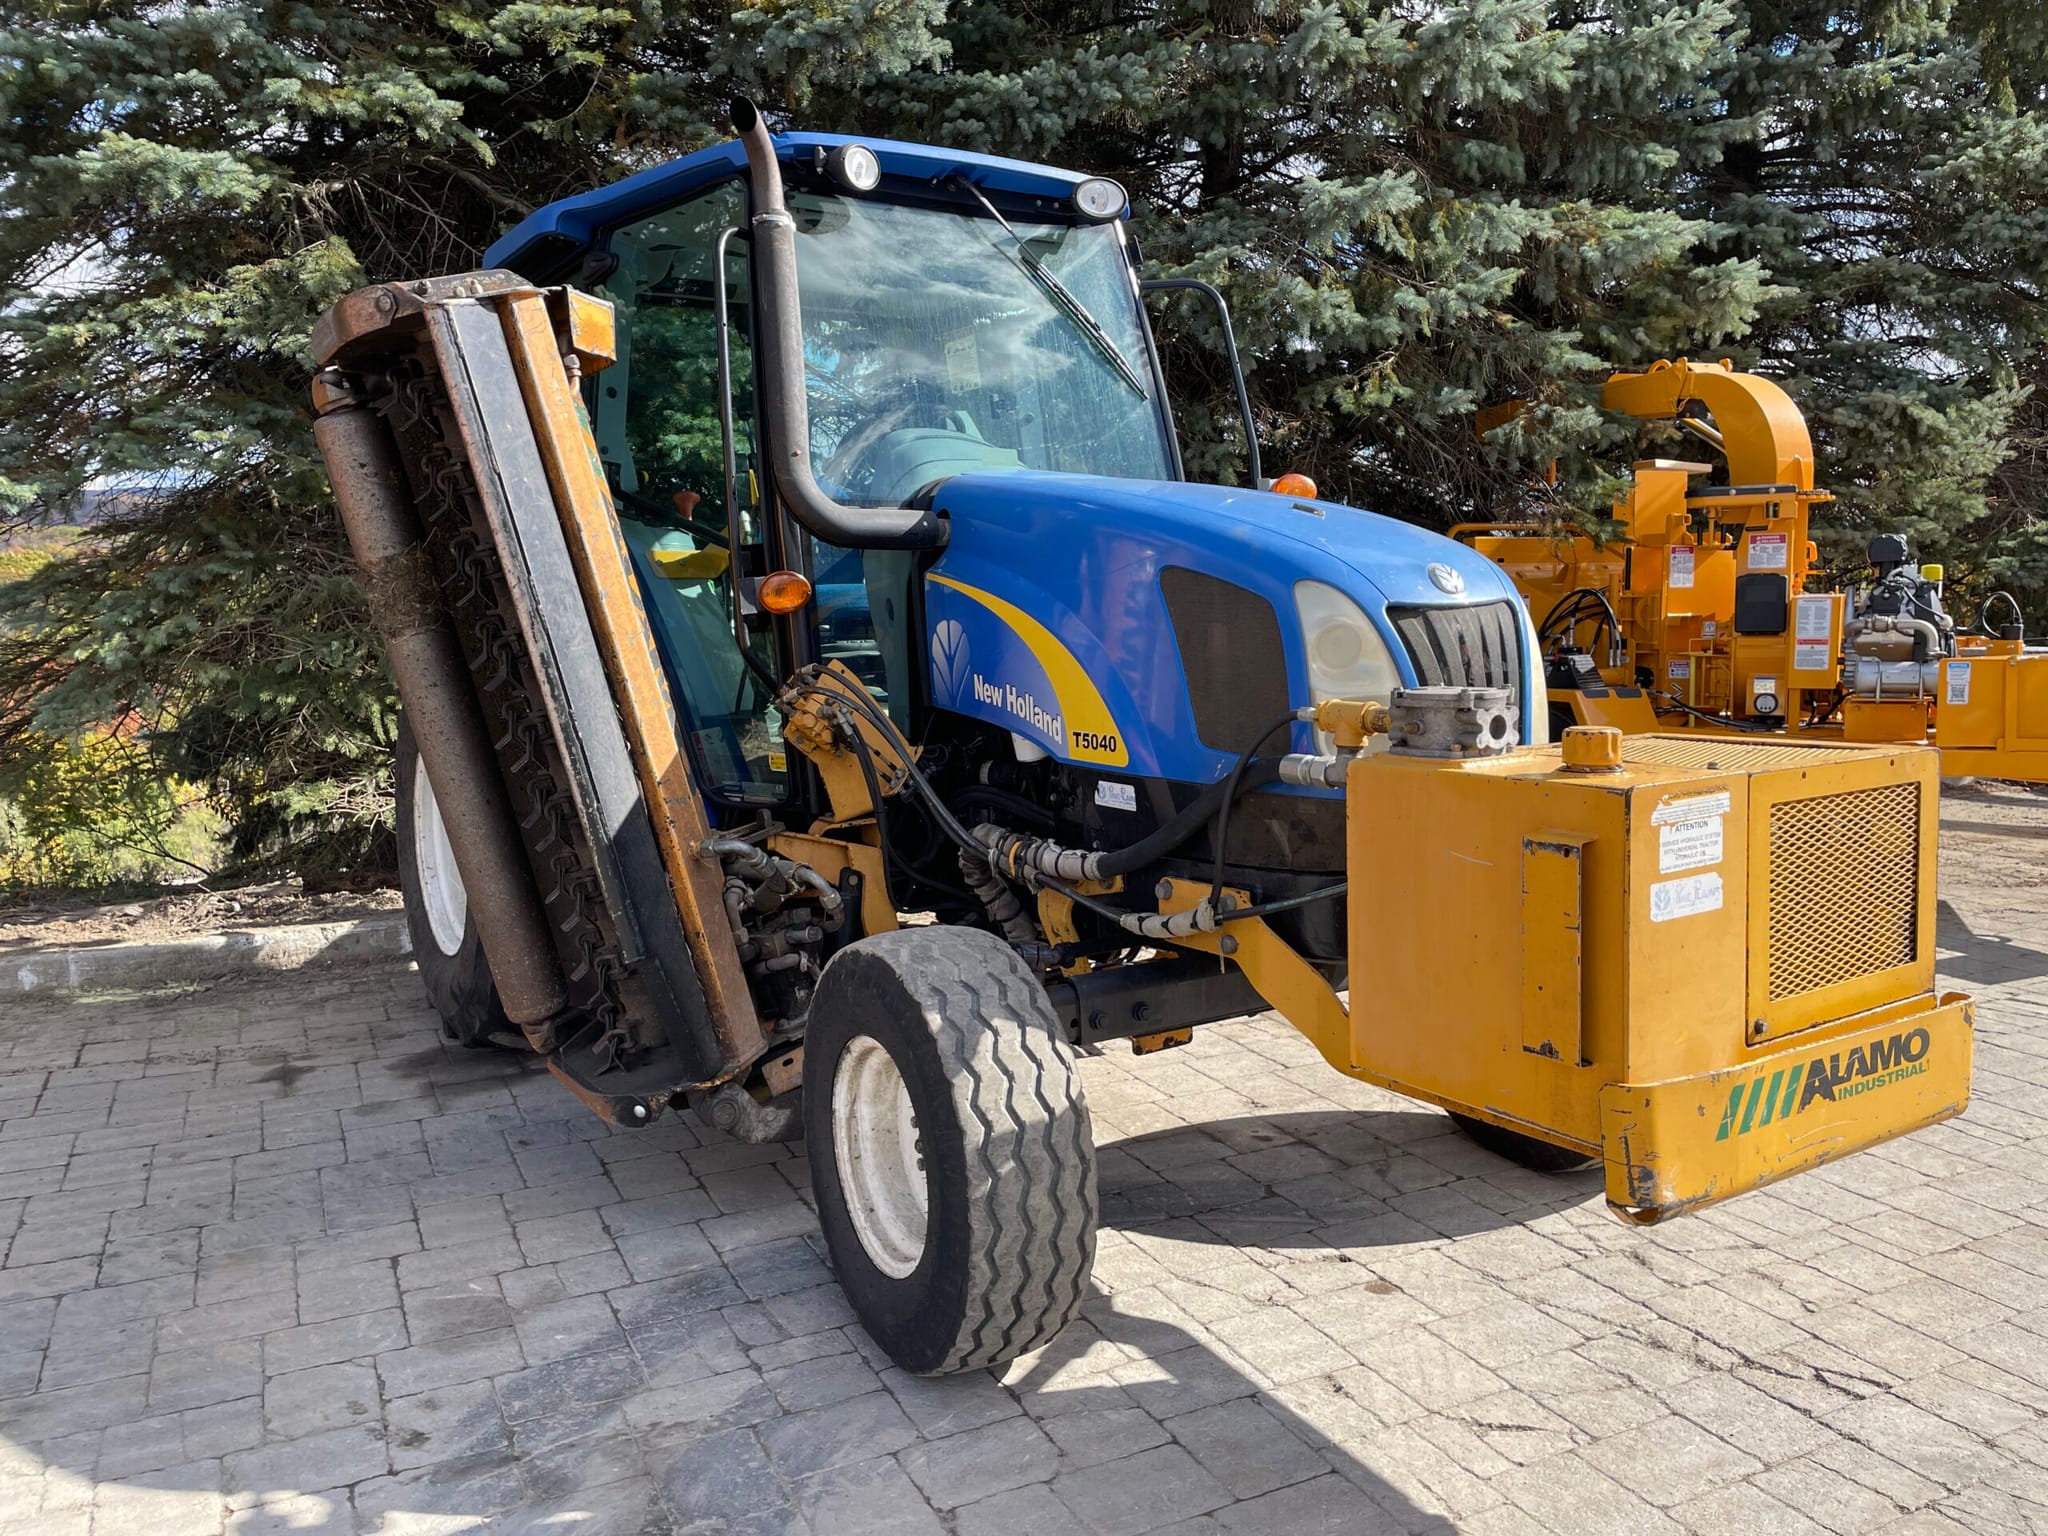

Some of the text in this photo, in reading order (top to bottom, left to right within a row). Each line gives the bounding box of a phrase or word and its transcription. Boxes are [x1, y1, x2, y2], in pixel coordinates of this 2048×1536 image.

[973, 674, 1063, 745] New Holland
[1073, 731, 1117, 753] T5040
[1674, 819, 1709, 833] ATTENTION
[1797, 1027, 1931, 1114] ALAMO
[1838, 1061, 1927, 1101] INDUSTRIAL
